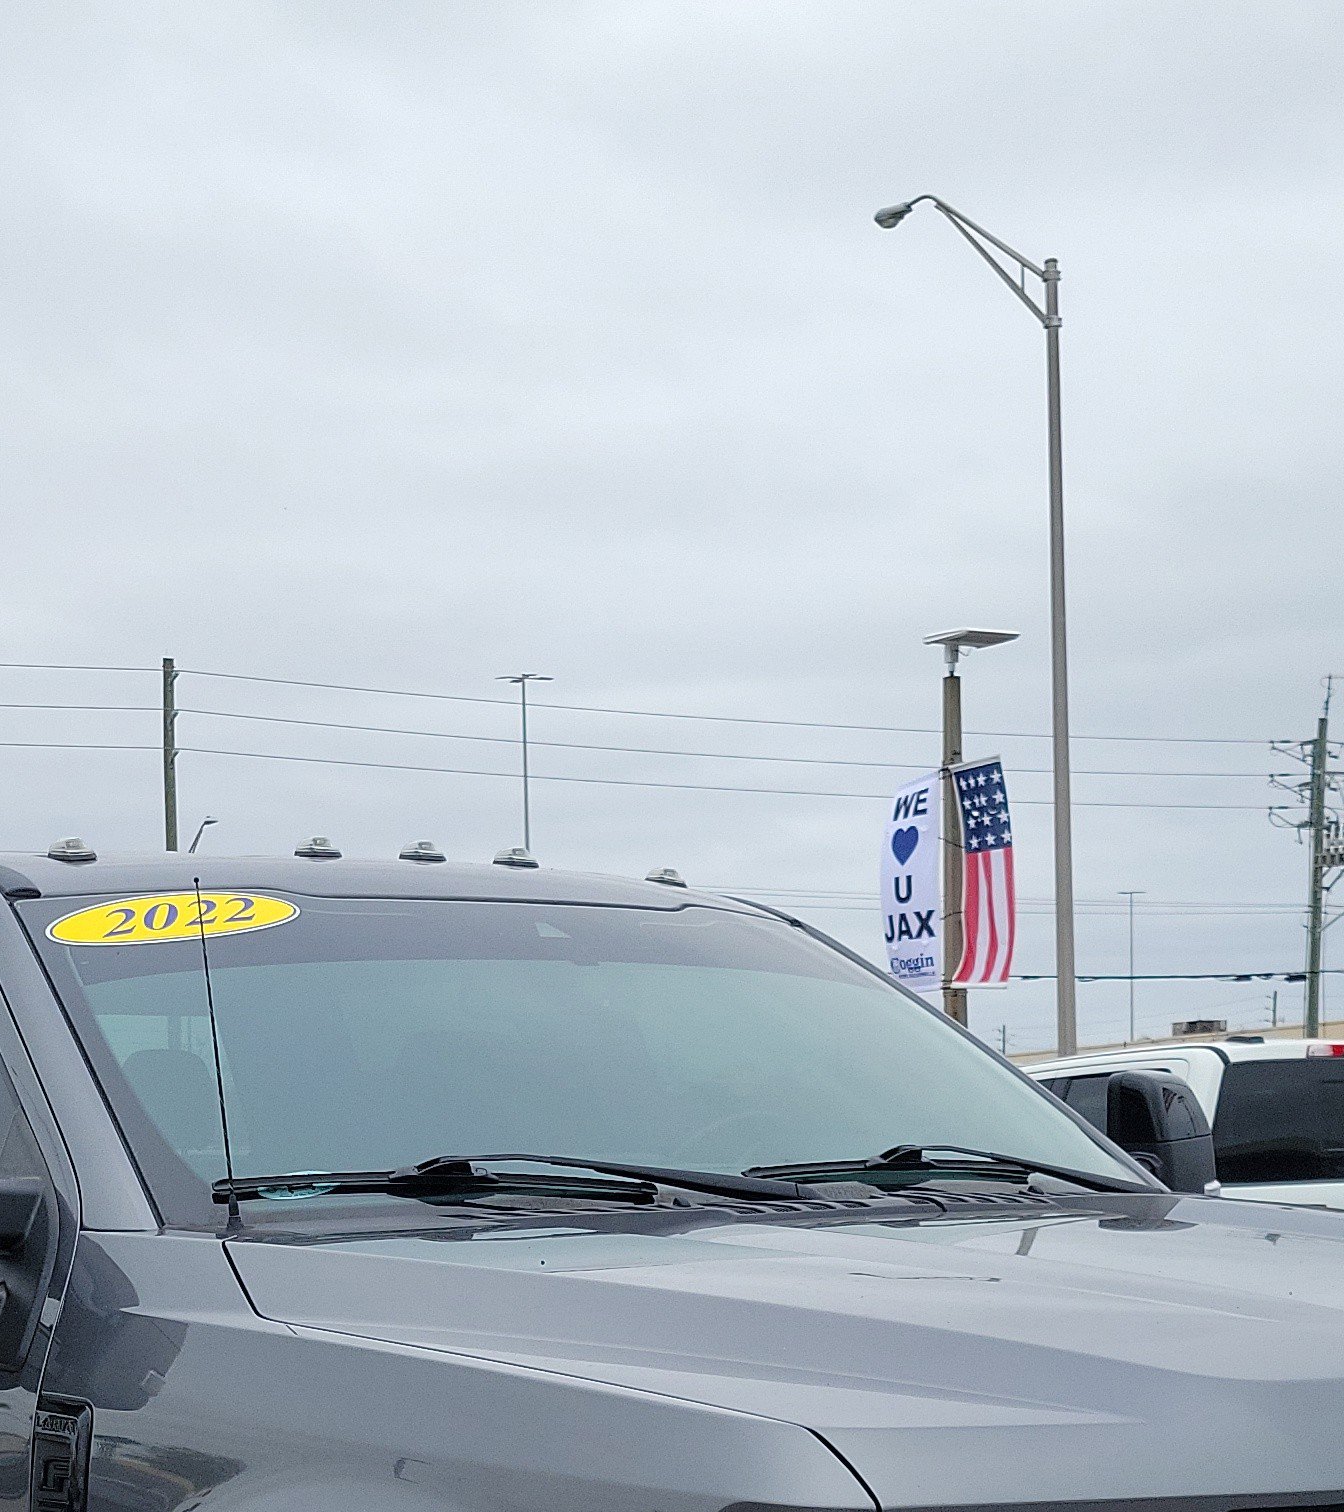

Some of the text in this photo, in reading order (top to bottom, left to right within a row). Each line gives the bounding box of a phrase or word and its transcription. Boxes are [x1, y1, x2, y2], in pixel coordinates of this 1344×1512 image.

[893, 788, 929, 821] WE
[894, 875, 912, 904] U
[102, 897, 256, 938] 2022
[885, 909, 936, 944] JAX
[890, 953, 935, 975] Coggin
